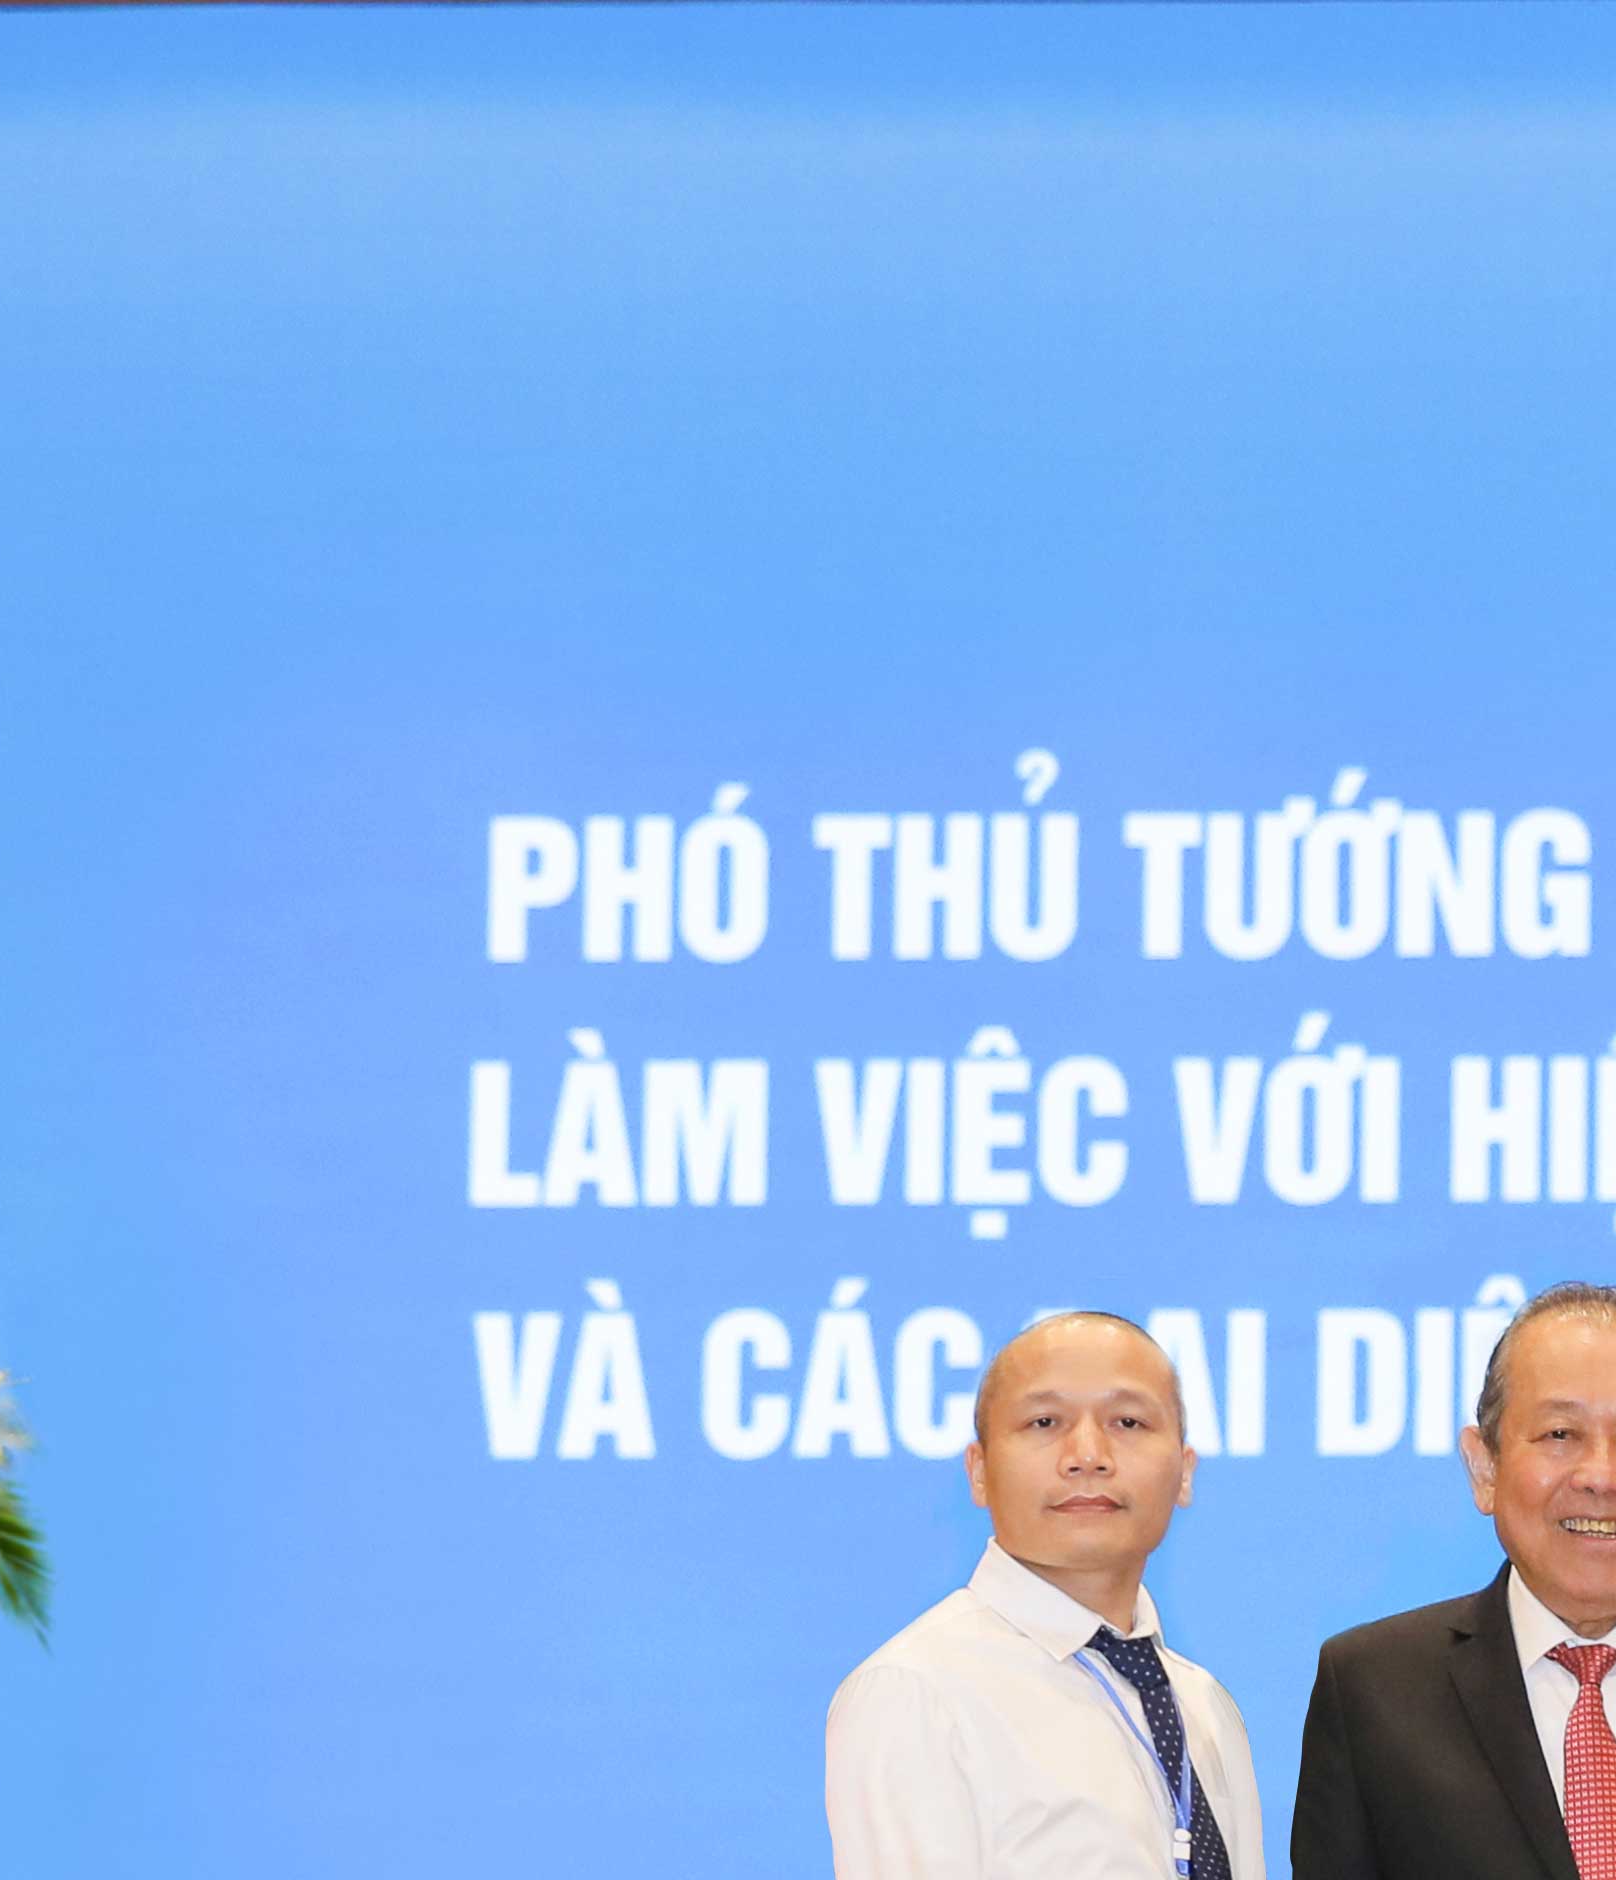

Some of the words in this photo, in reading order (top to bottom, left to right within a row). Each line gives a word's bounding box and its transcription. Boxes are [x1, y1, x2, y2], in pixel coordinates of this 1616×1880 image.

[489, 784, 768, 962] PHÓ
[815, 752, 1078, 960] THỦ
[1125, 769, 1590, 959] TƯỚNG
[470, 1029, 768, 1206] LÀM
[816, 1027, 1127, 1238] VIỆC
[1175, 1013, 1399, 1204] VỚI
[475, 1280, 655, 1458] VÀ
[700, 1277, 983, 1461] CÁC
